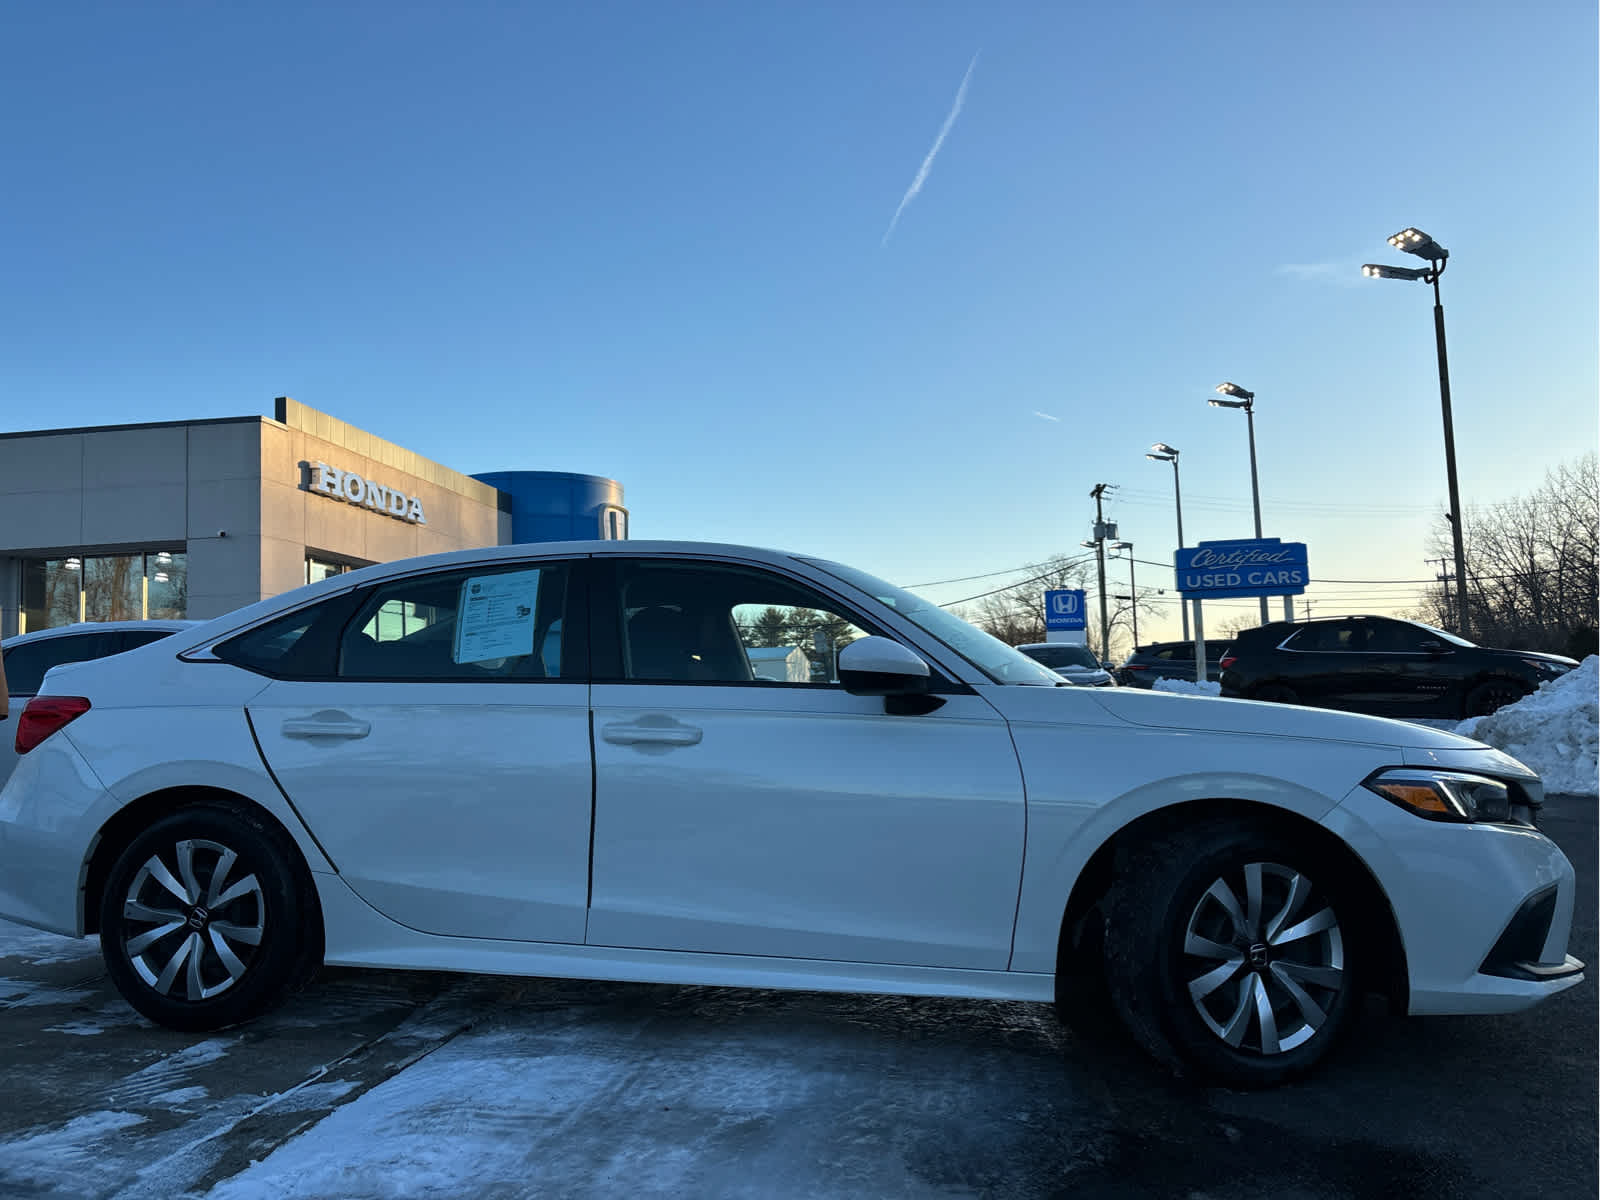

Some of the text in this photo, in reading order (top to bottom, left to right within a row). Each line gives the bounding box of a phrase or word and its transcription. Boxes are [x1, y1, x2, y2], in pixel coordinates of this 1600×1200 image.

[313, 463, 427, 524] HONDA
[1191, 549, 1294, 570] Certified
[1186, 571, 1302, 588] USED CARS
